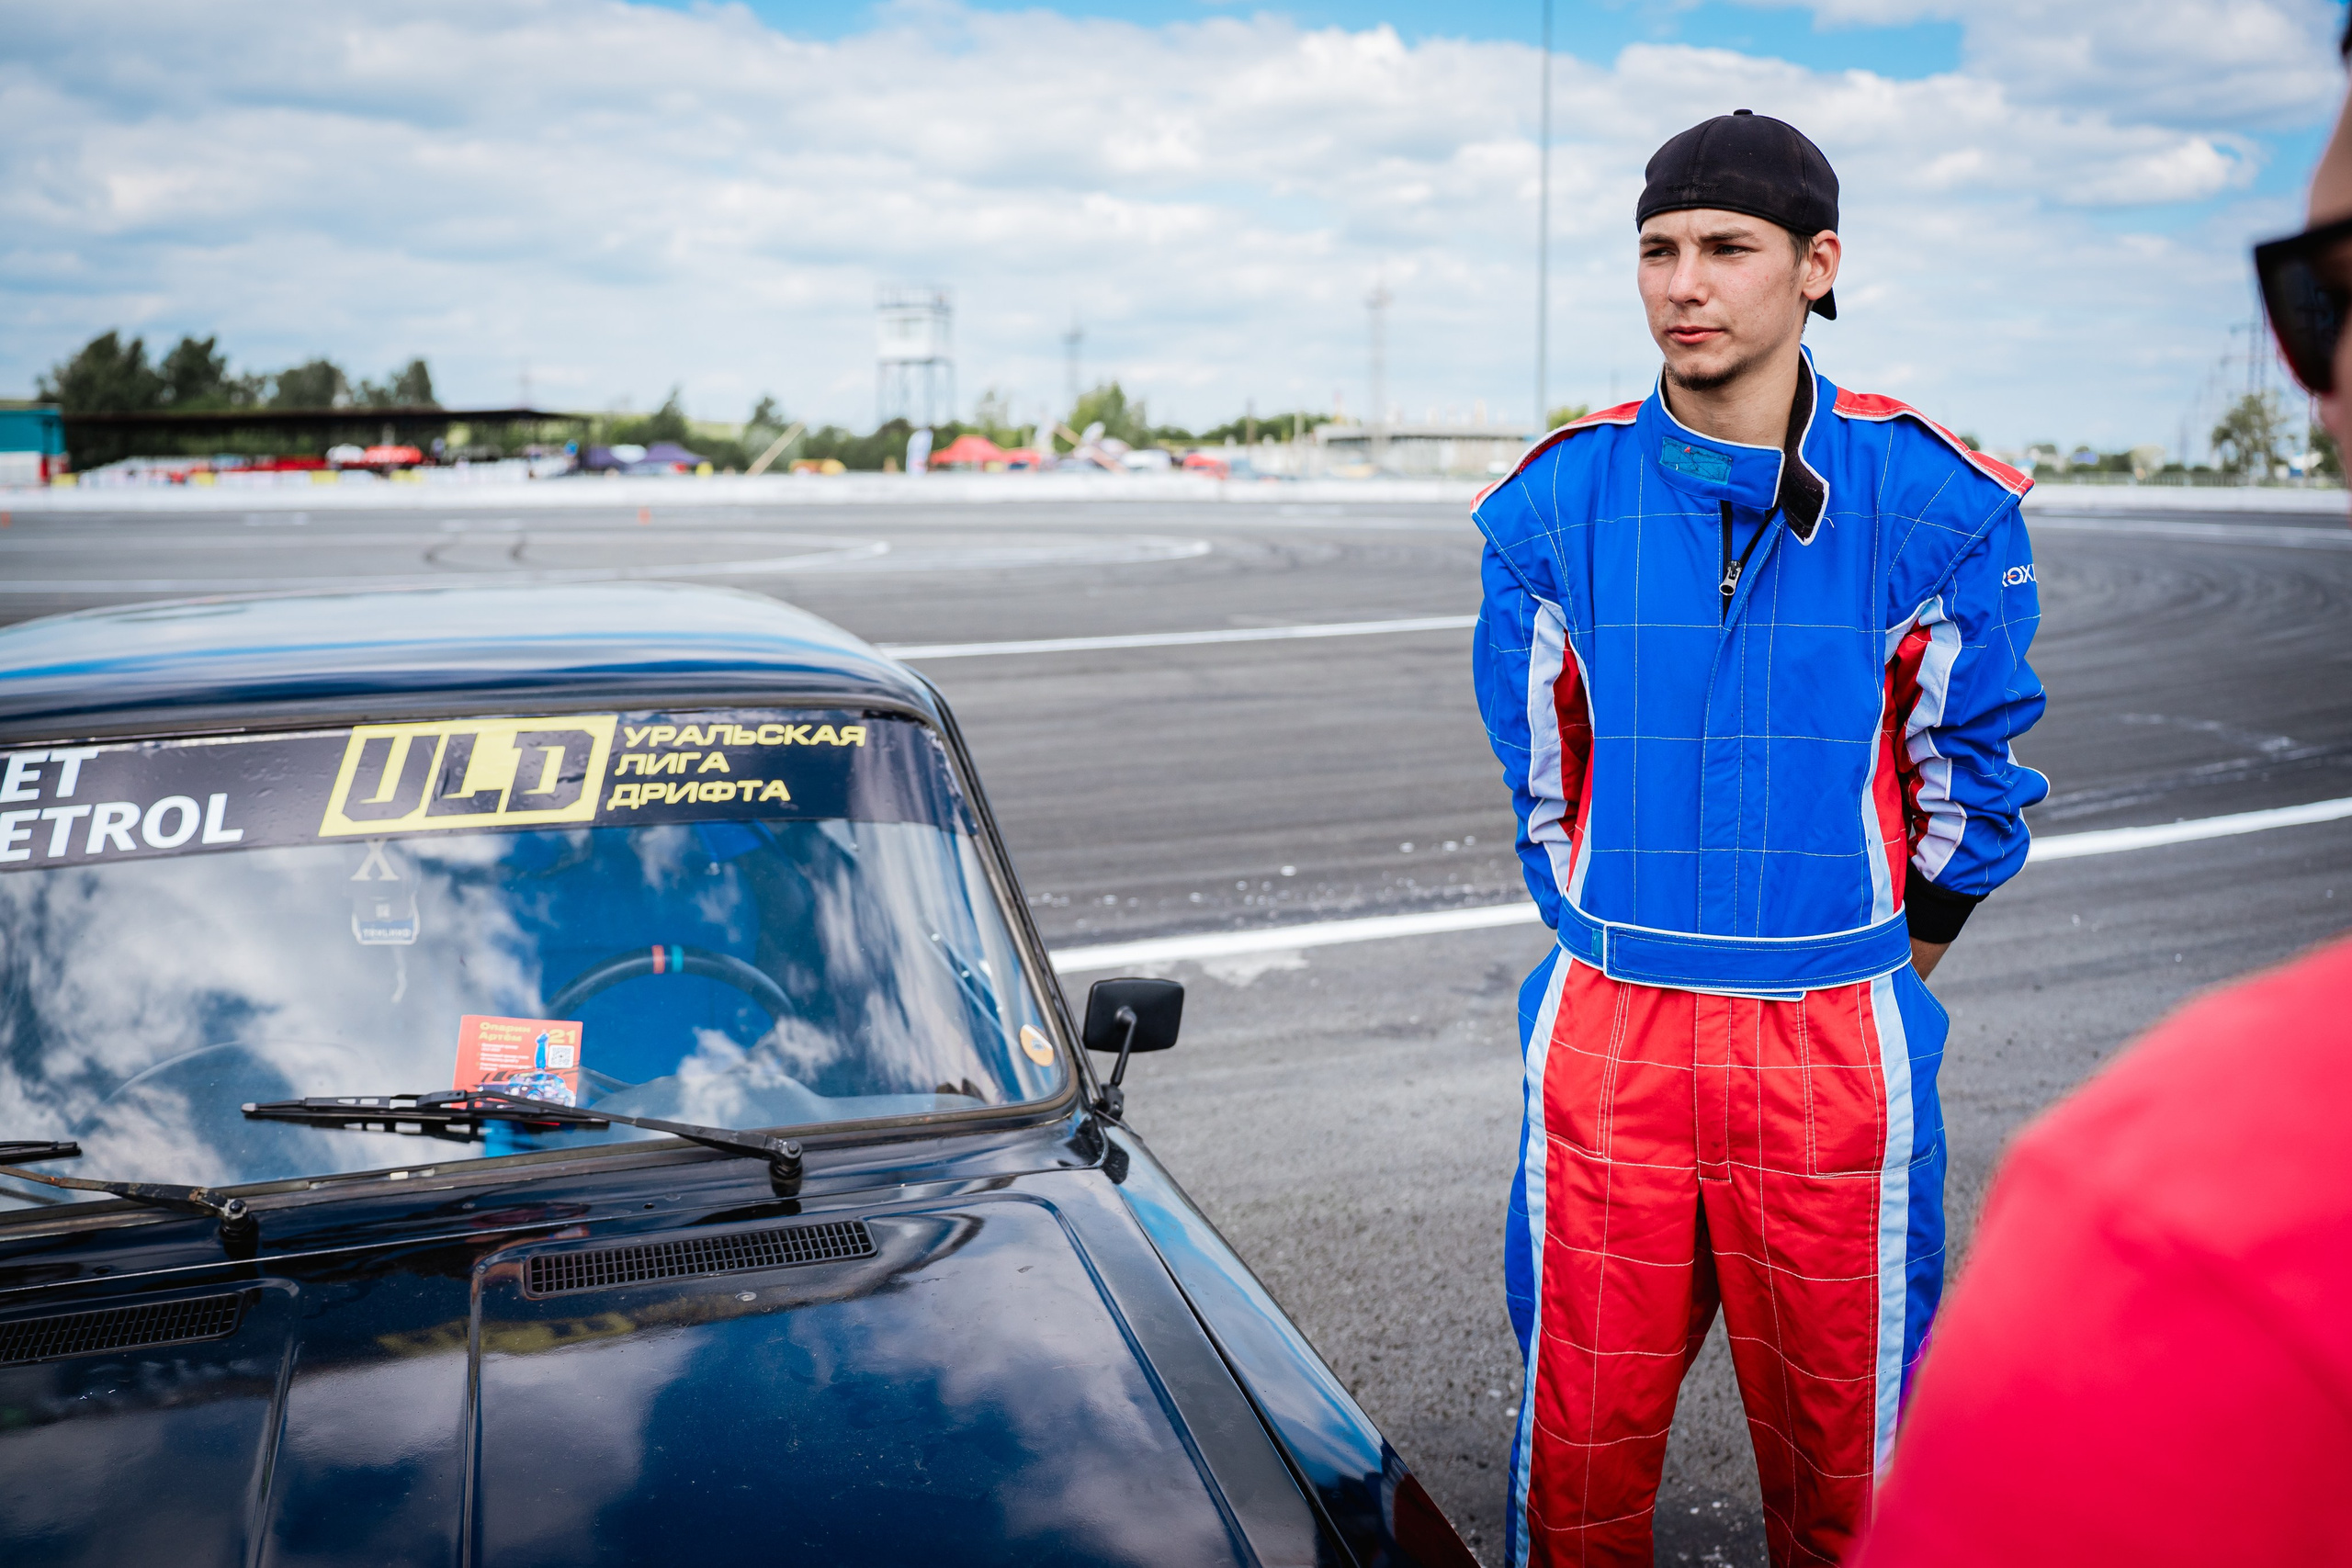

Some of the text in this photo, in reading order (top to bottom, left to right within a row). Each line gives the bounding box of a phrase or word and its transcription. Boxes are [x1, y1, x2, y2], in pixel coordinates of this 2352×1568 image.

[623, 724, 866, 748] УРАЛЬСКАЯ
[0, 749, 99, 803] ET
[615, 751, 730, 776] ЛИГА
[605, 780, 791, 811] ДРИФТА
[0, 793, 244, 863] ETROL
[548, 1028, 576, 1044] 21
